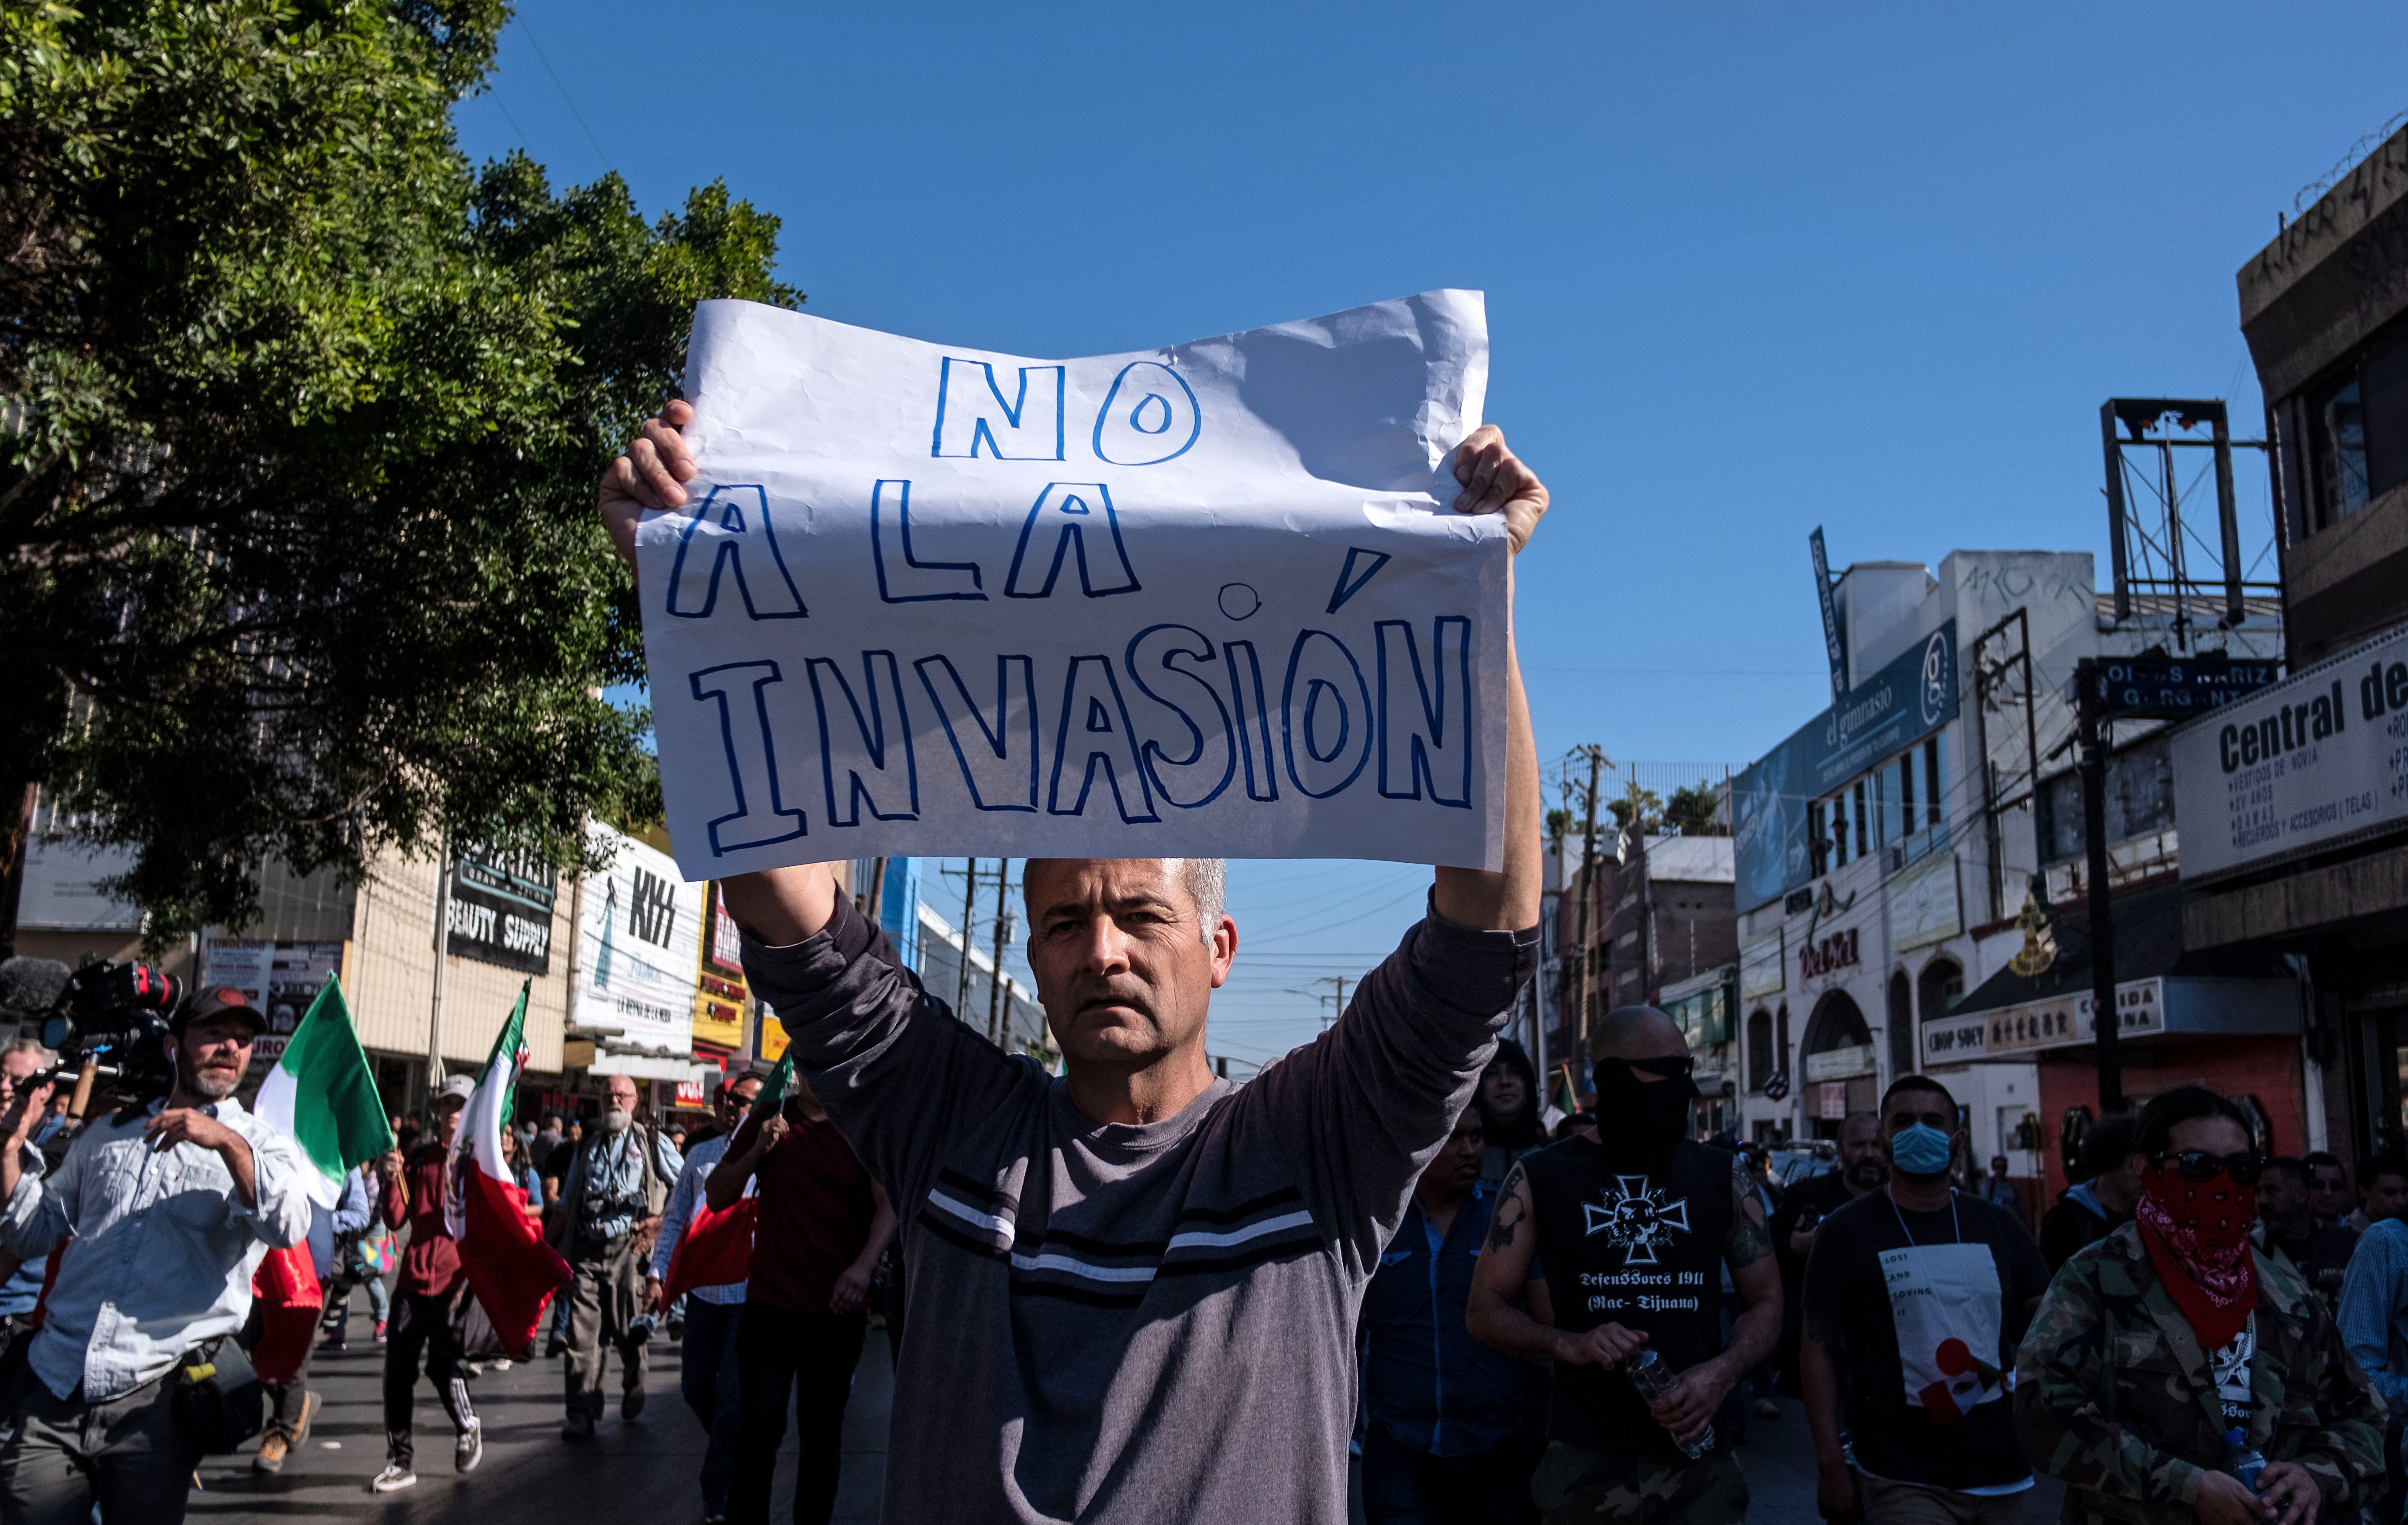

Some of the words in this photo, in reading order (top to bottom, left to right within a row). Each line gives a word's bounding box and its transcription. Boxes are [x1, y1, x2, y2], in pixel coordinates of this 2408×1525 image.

[931, 356, 1201, 466] NO
[666, 482, 807, 620] A
[872, 479, 1142, 602] LA
[2219, 679, 2344, 774] Central
[2360, 661, 2408, 721] de
[2234, 763, 2271, 791] VESTIDOS
[2274, 758, 2285, 778] DE
[2291, 746, 2317, 771] NOVIA
[2290, 802, 2337, 831] ACCESORIOS
[447, 898, 497, 944] BEAUTY
[504, 913, 549, 958] SUPPLY
[1957, 1025, 1984, 1048] SUEY
[1677, 1270, 1703, 1285] 1911
[1889, 1271, 1910, 1282] AND
[1893, 1287, 1931, 1300] LOVING
